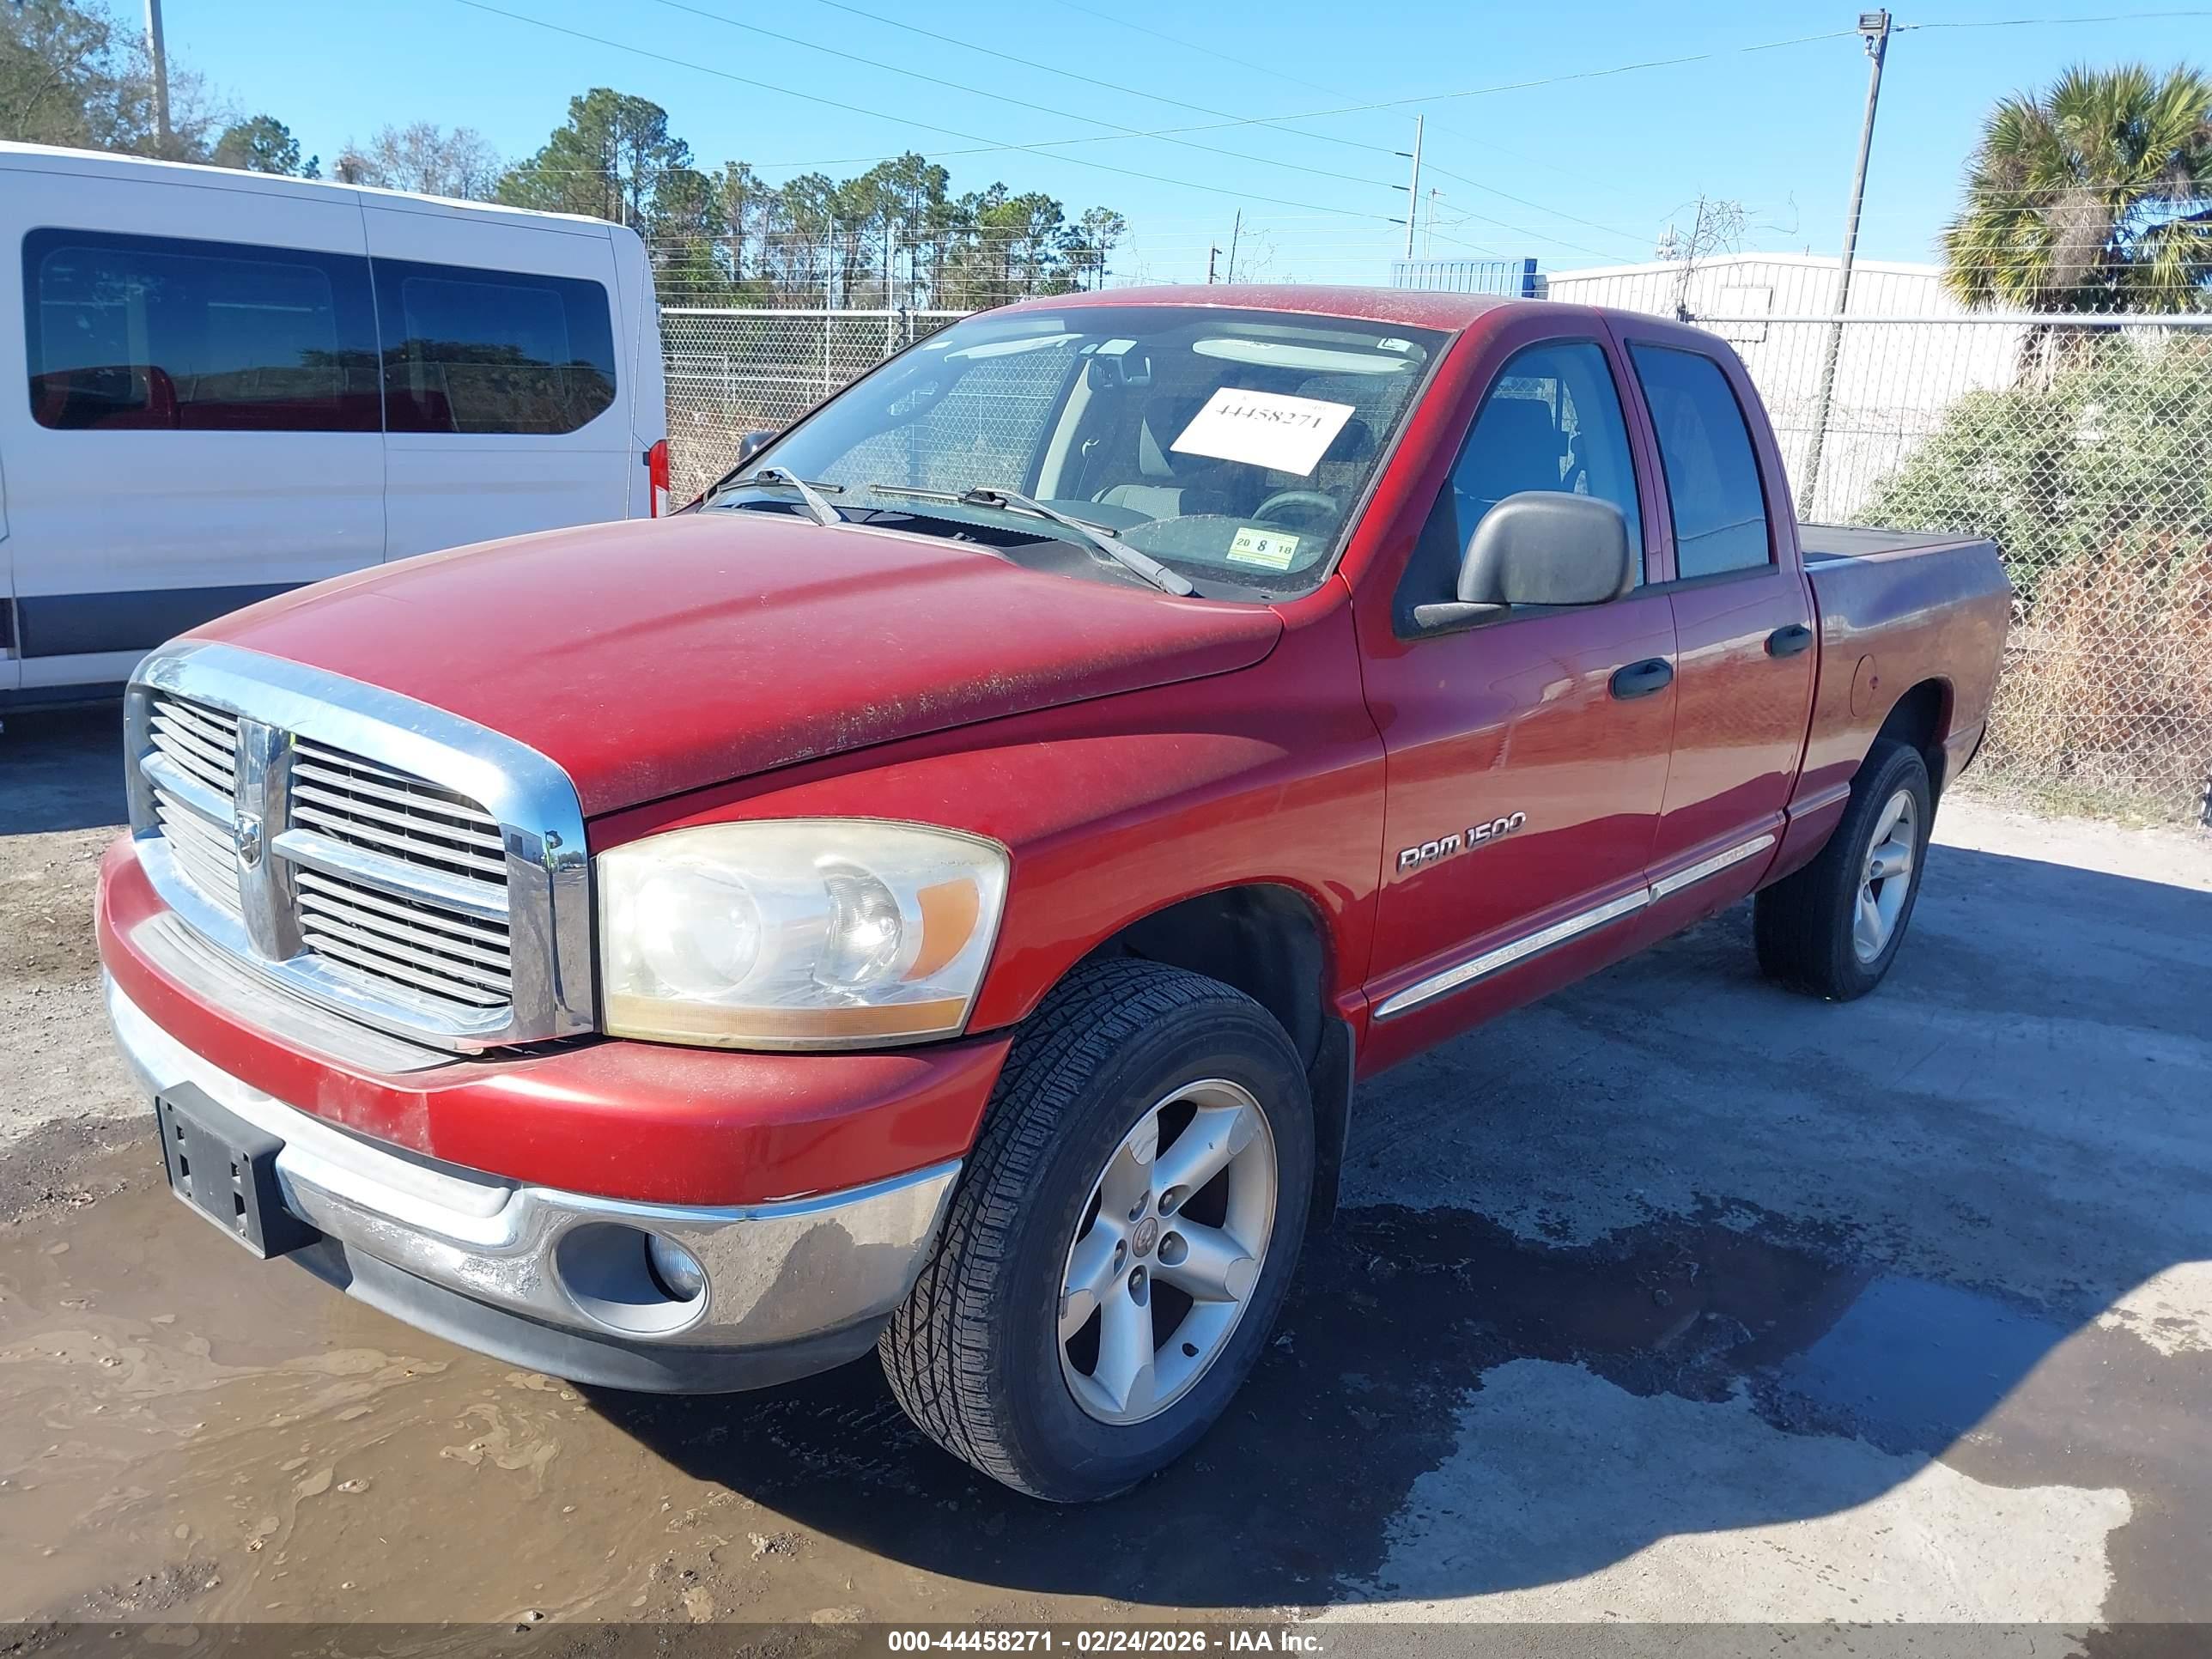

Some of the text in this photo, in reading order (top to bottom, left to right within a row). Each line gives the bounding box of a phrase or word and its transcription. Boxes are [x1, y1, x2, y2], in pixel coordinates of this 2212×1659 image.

[1215, 404, 1322, 428] 44458271
[1237, 538, 1292, 555] 20 8 18
[1396, 811, 1527, 875] RAM 1500
